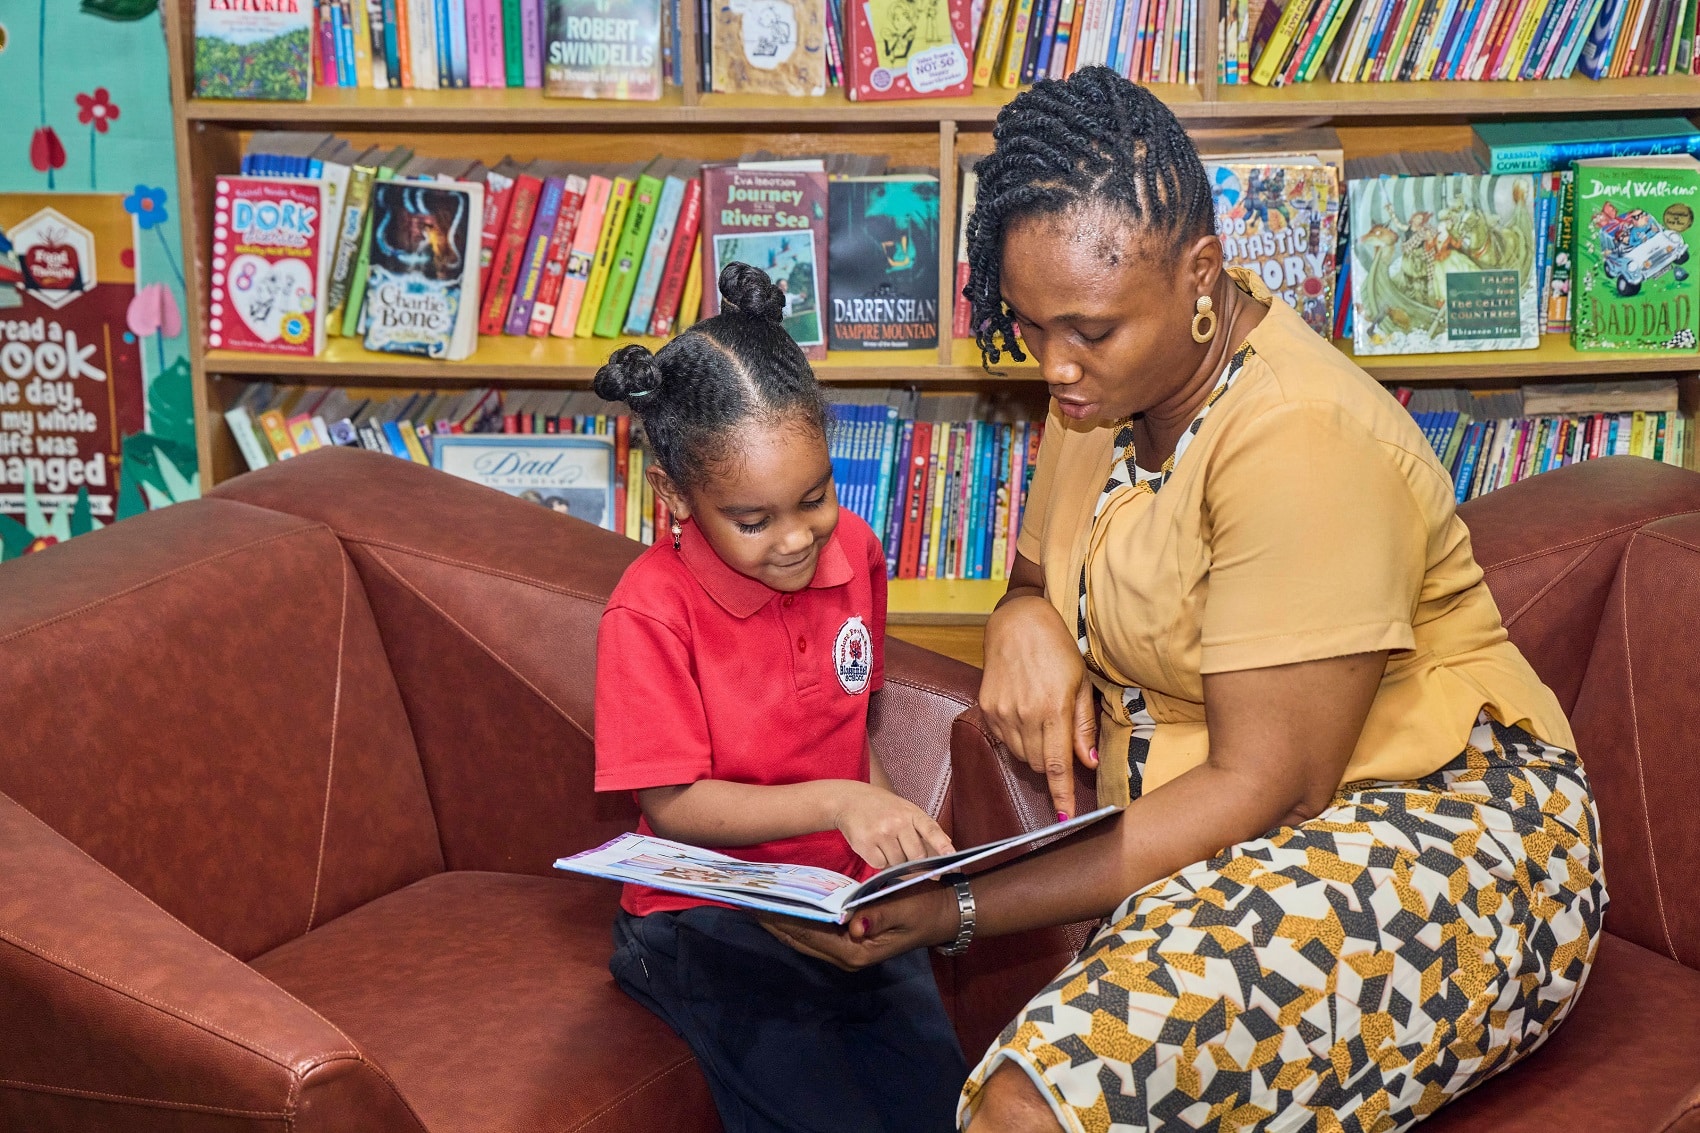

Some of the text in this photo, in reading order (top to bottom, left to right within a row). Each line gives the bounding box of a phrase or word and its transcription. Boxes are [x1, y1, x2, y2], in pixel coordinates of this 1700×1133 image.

[567, 16, 639, 41] ROBERT
[549, 41, 653, 67] SWINDELLS
[1496, 160, 1538, 172] COWELL
[727, 184, 804, 207] Journey
[1581, 179, 1698, 199] David Walliams
[235, 202, 315, 235] DORK
[721, 208, 809, 229] River Sea
[380, 285, 444, 312] Charlie
[834, 298, 937, 322] DARREN SHAN
[382, 309, 439, 330] Bone
[1590, 294, 1691, 336] BAD DAD
[48, 321, 63, 341] a
[834, 323, 936, 339] VAMPIRE MOUNTAIN
[25, 376, 82, 414] day,
[2, 408, 97, 435] my whole
[36, 436, 78, 456] was
[482, 450, 566, 476] Dad
